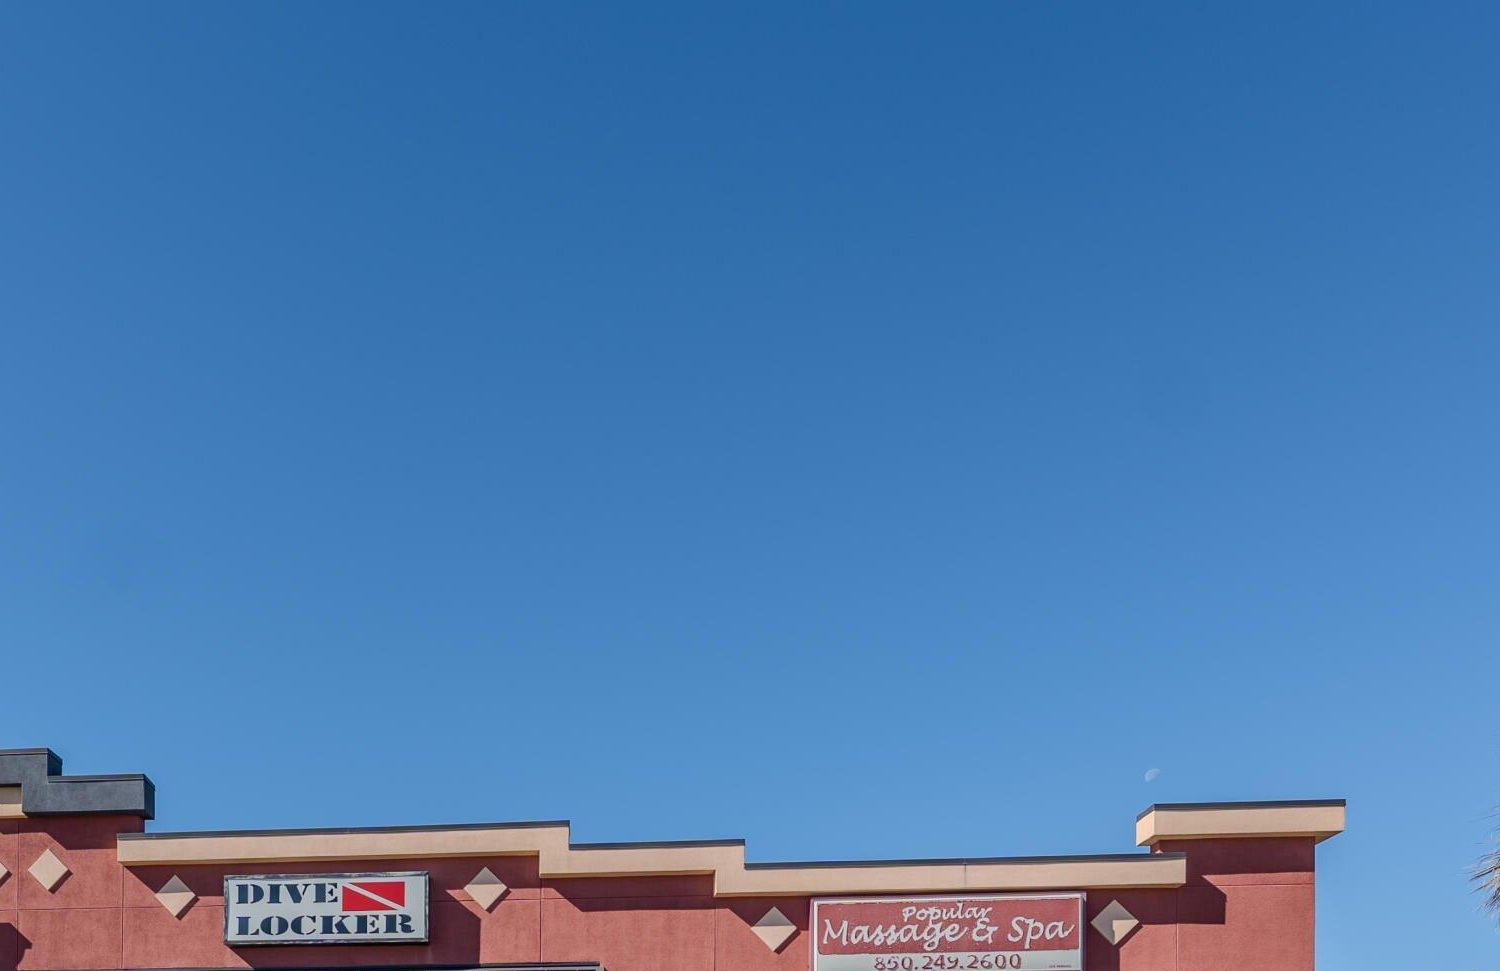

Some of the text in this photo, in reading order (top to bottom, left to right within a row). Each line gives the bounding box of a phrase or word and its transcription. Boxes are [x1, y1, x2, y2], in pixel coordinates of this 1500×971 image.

[236, 882, 338, 904] DIVE
[236, 914, 415, 936] LOCKER
[902, 903, 993, 925] Popular
[822, 916, 1075, 951] Massage & Spa
[874, 953, 1022, 971] 850.249.2600
